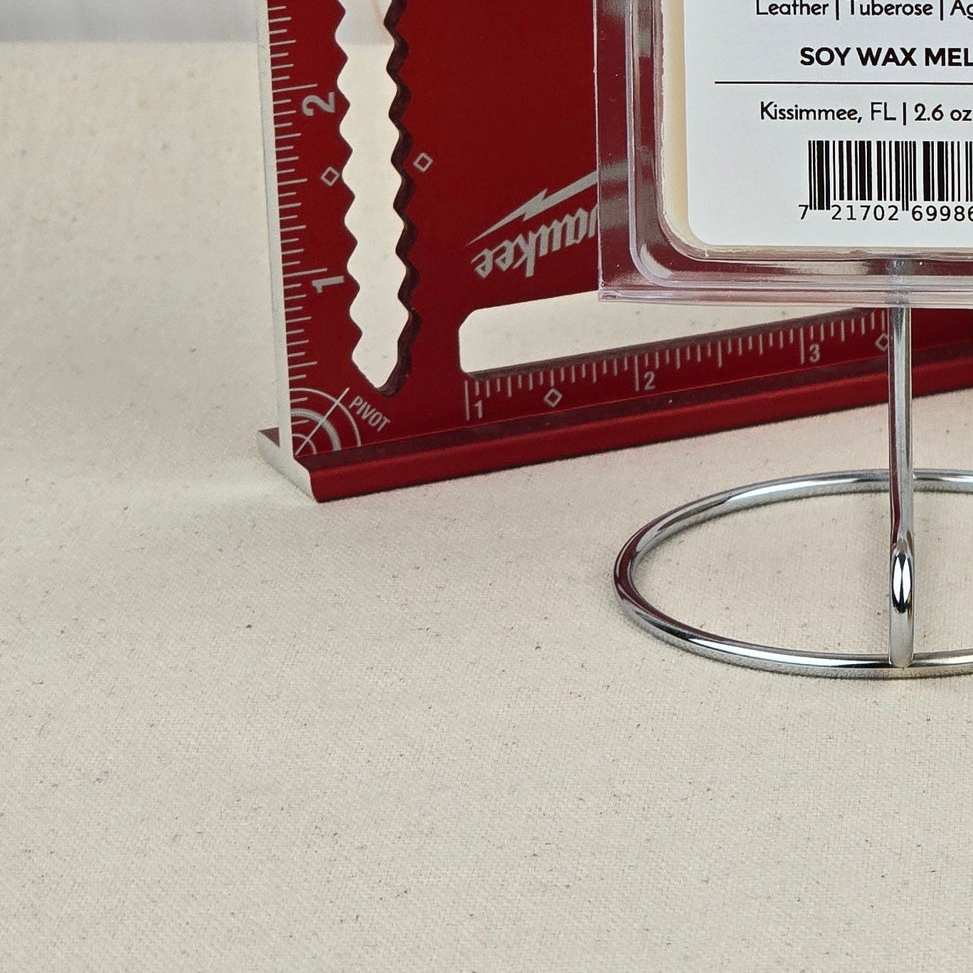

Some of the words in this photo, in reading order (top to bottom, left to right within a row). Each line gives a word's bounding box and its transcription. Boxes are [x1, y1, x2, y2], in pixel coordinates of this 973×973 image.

[800, 47, 851, 66] SOY
[856, 47, 917, 66] WAX
[302, 92, 335, 116] 2
[761, 101, 862, 123] Kissimmee,
[871, 102, 896, 120] FL
[915, 103, 944, 121] 2.6
[950, 109, 972, 121] oz
[799, 205, 808, 220] 7
[831, 204, 898, 220] 21702
[312, 276, 344, 293] 1
[809, 344, 820, 363] 3
[644, 371, 655, 390] 2
[349, 395, 391, 432] PIVOT
[474, 400, 483, 419] 1
